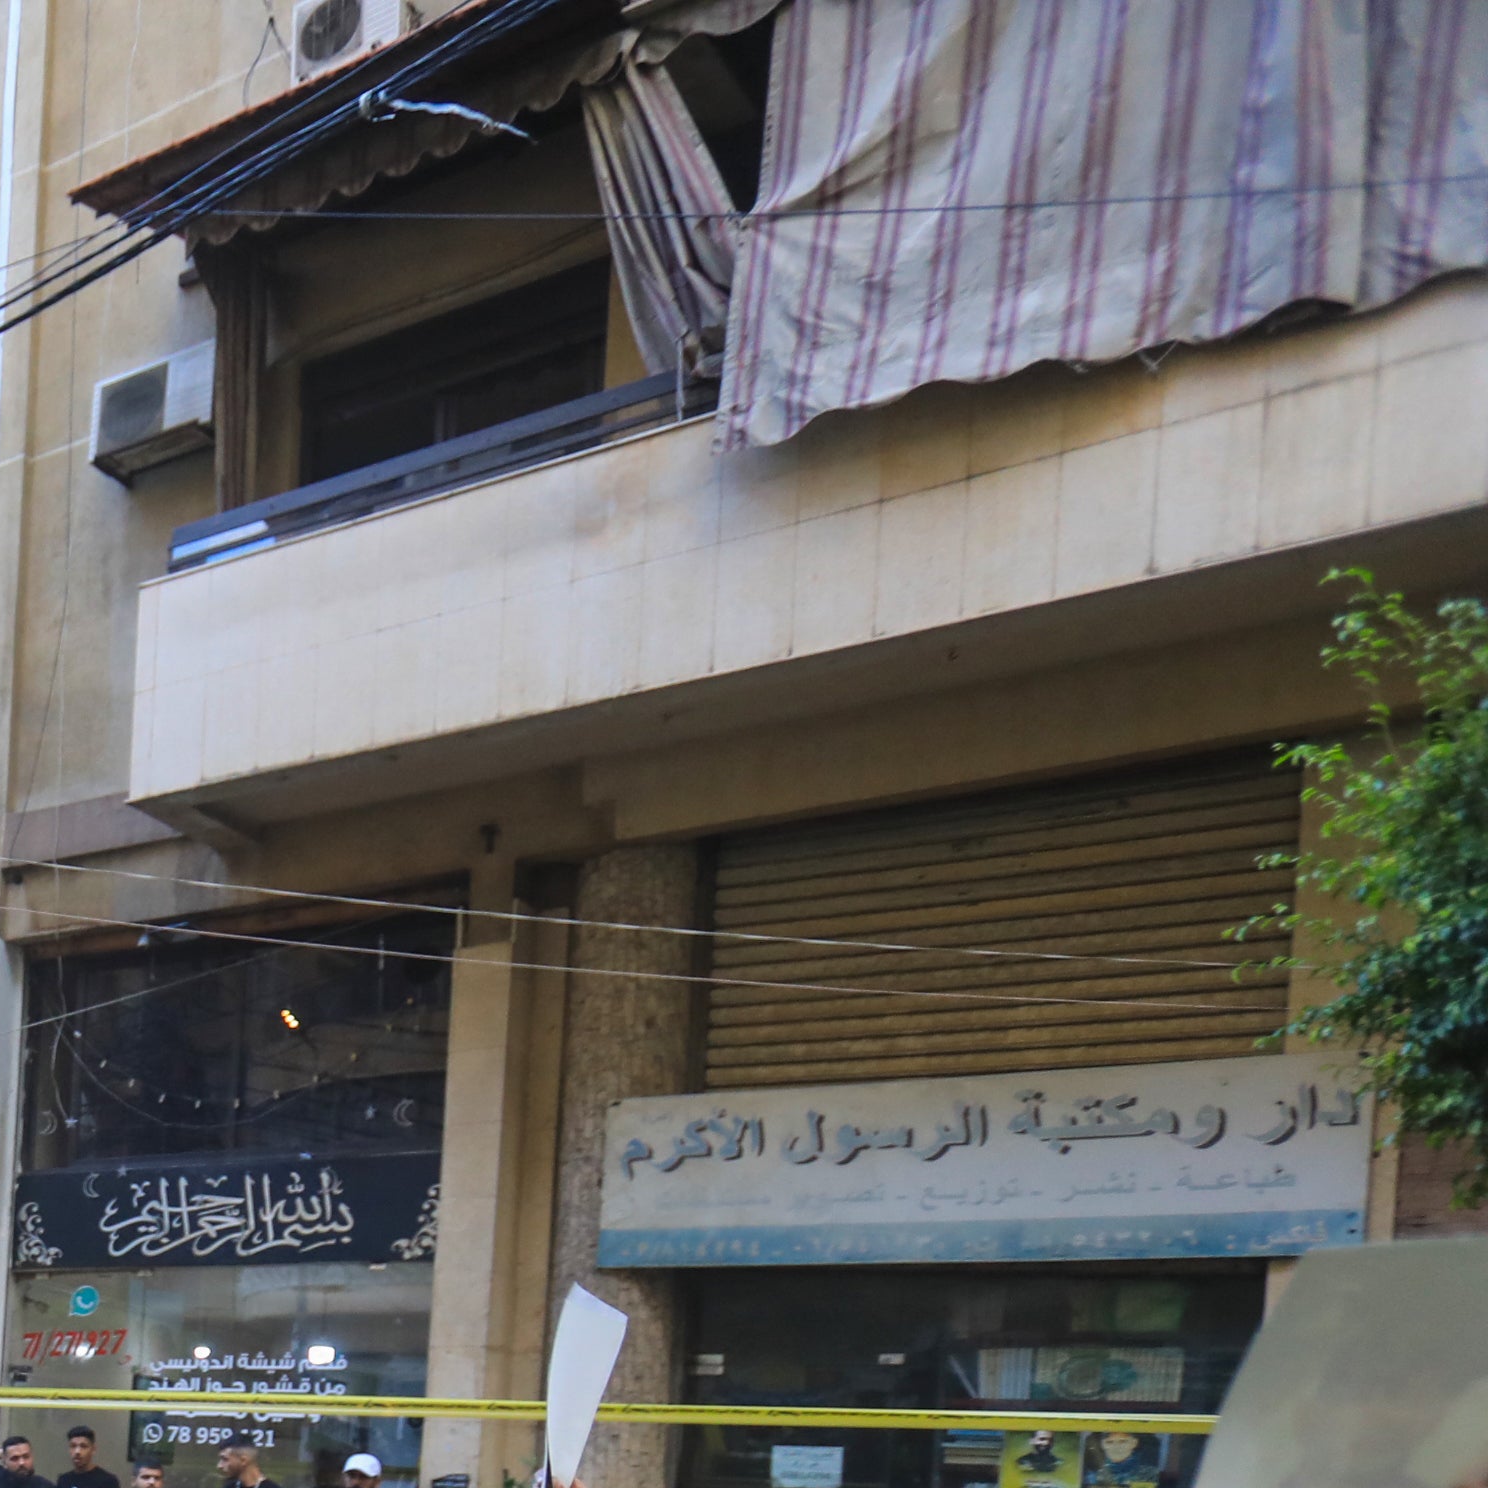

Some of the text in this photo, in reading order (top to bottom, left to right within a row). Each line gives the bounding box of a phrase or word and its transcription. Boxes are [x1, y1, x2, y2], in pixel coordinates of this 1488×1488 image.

[782, 1104, 987, 1166] الرسول
[1243, 1083, 1360, 1145] دار
[167, 1425, 191, 1443] 78
[240, 1428, 275, 1447] 21
